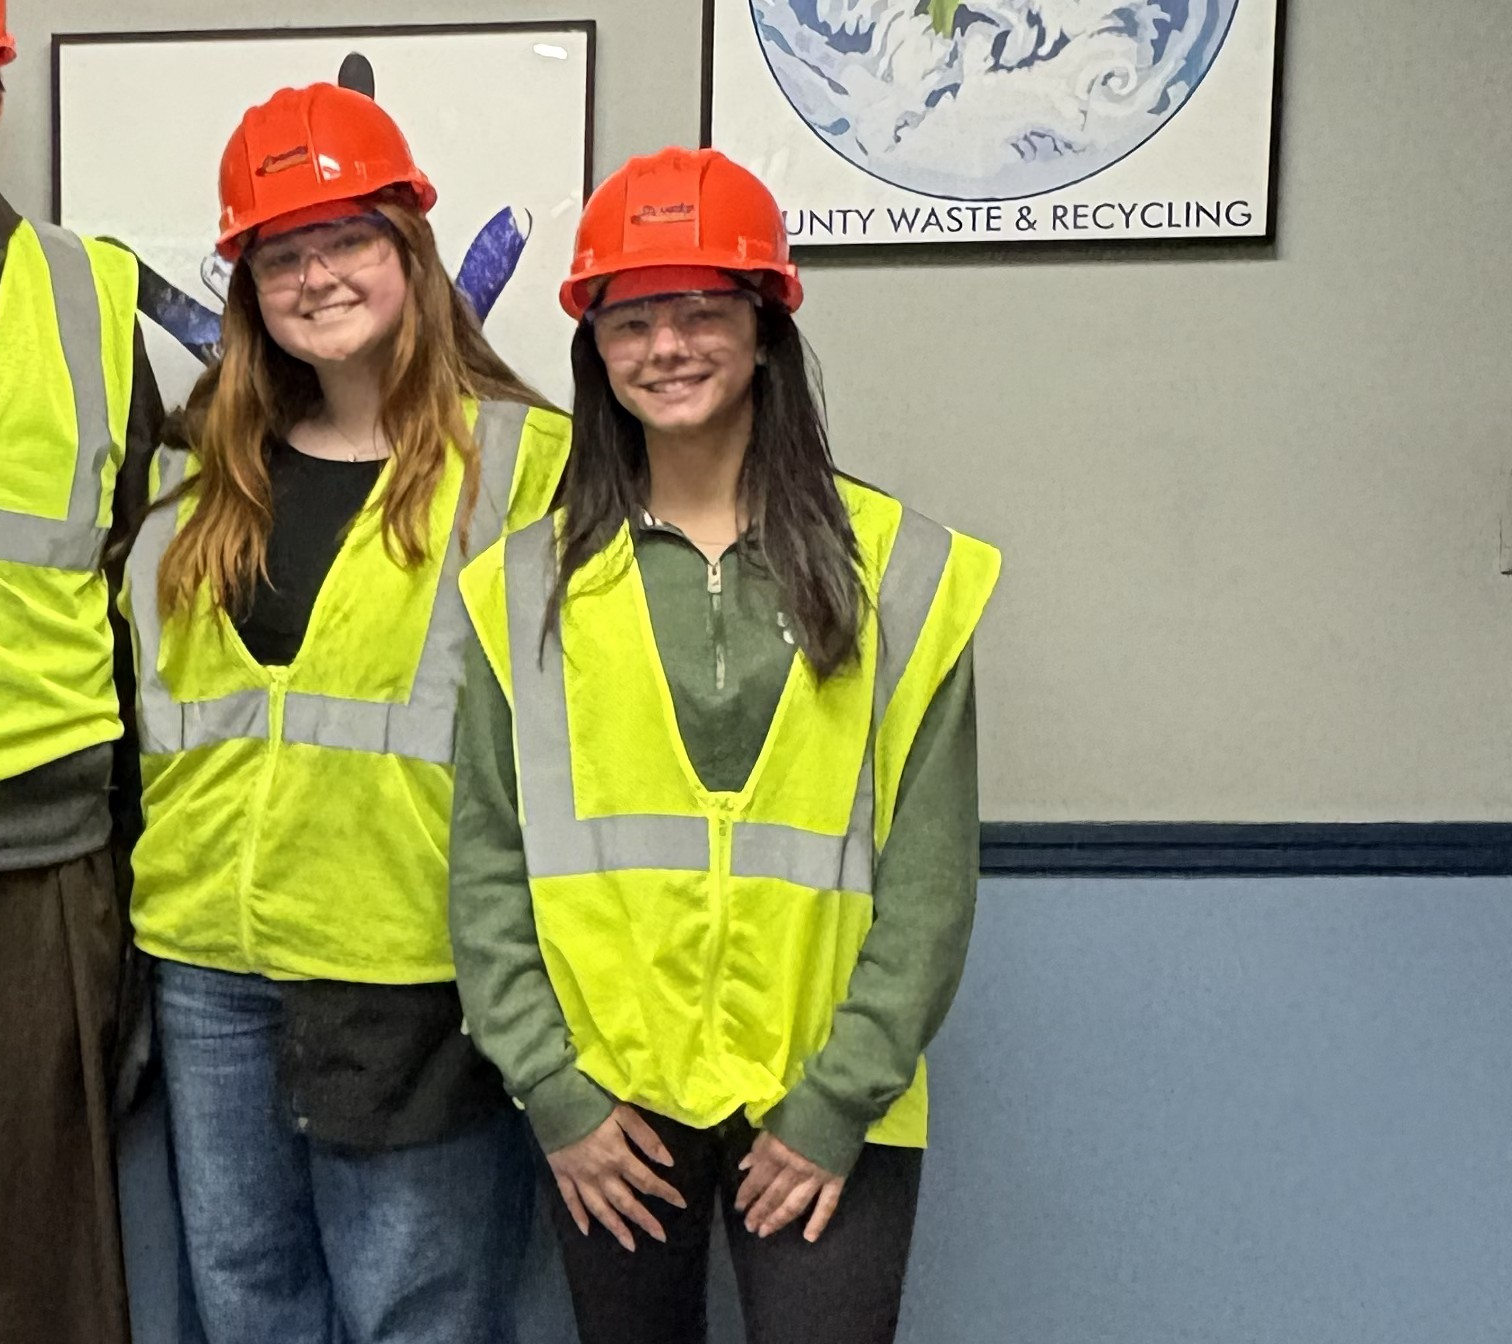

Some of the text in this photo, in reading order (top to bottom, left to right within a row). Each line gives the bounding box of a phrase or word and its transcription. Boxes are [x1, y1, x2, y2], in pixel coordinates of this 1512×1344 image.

[782, 200, 1253, 236] UNTY WASTE & RECYCLING
